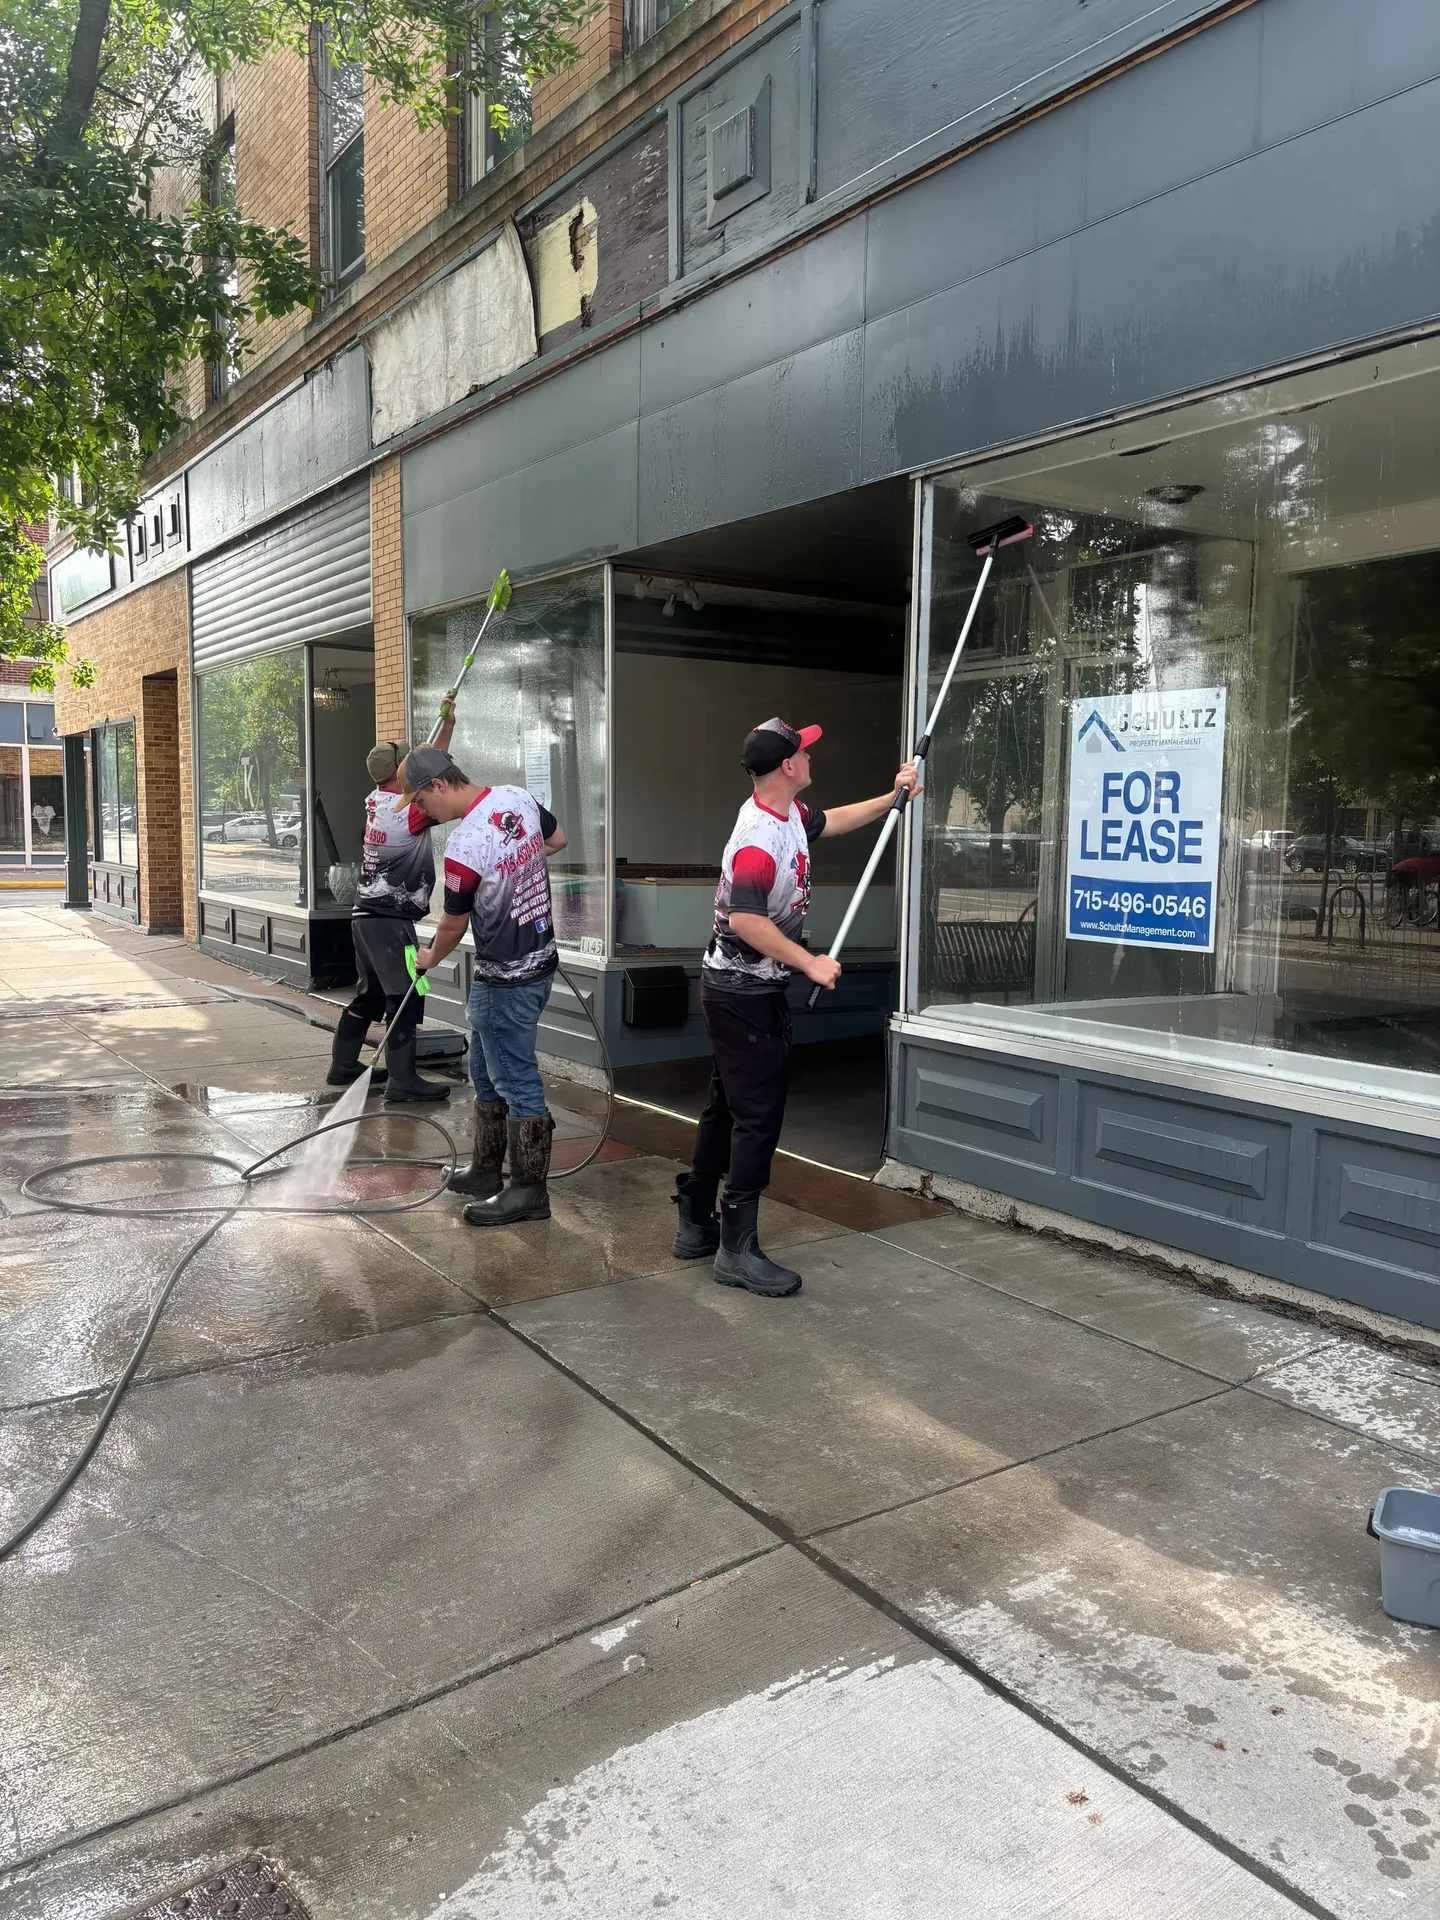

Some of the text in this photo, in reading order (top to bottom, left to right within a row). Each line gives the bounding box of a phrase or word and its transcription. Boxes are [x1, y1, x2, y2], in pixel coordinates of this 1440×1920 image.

[1119, 708, 1217, 733] SCHULTZ
[1129, 738, 1202, 748] PROPERTY MANAGEMENT
[1102, 770, 1181, 815] FOR
[1080, 819, 1204, 864] LEASE
[1073, 889, 1206, 919] 715-496-0546
[1080, 920, 1196, 939] www.SchultzManagement.com
